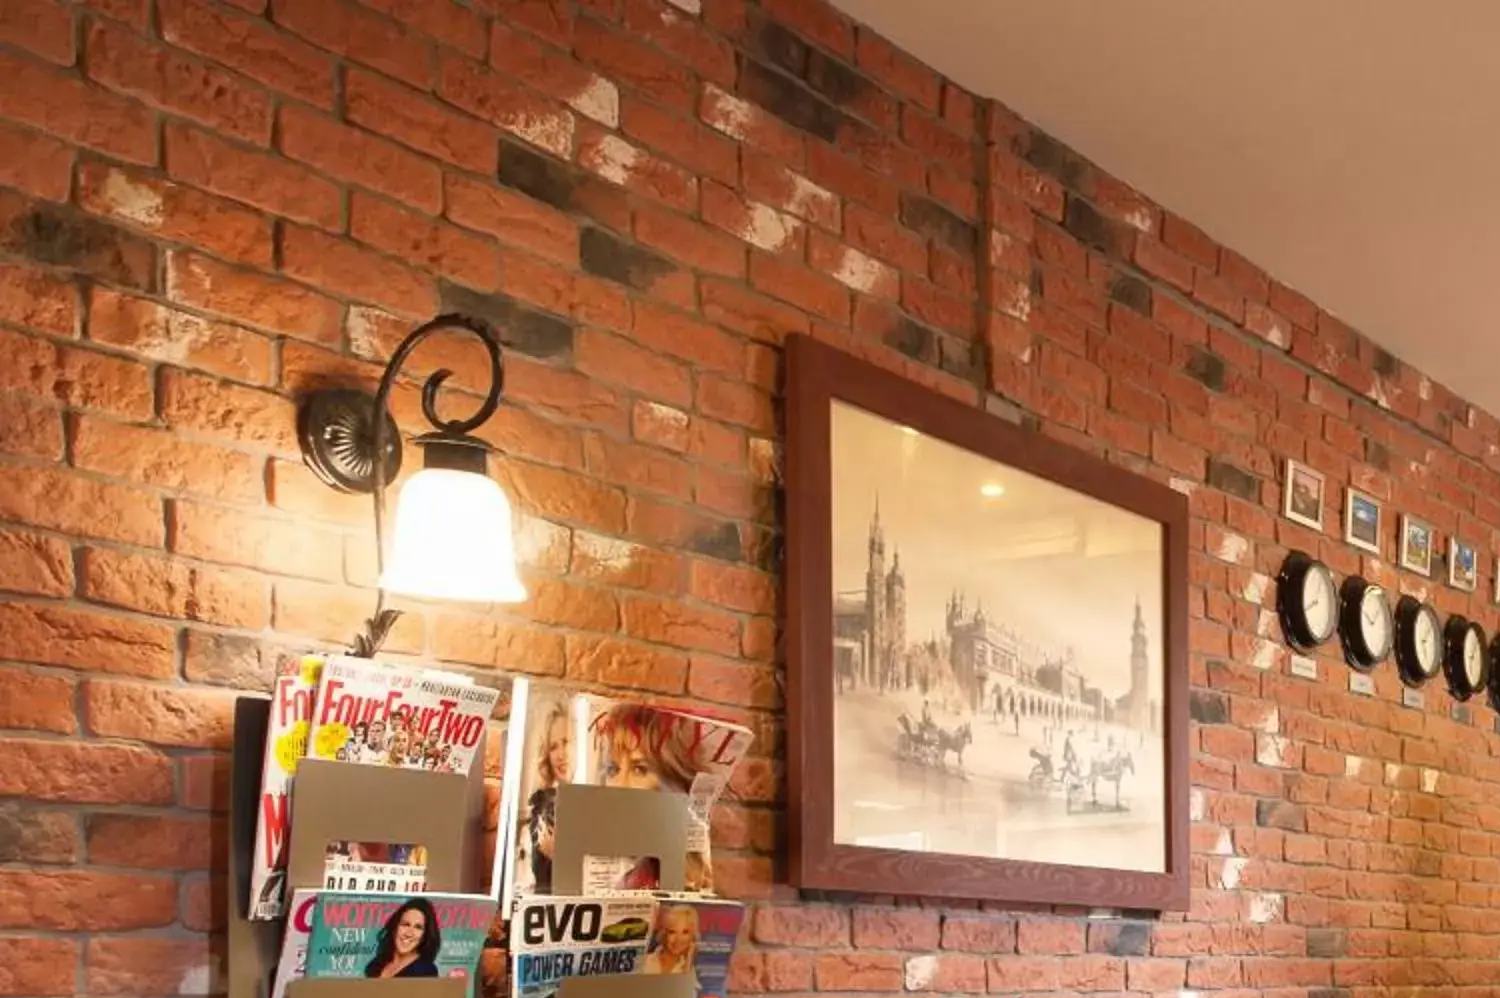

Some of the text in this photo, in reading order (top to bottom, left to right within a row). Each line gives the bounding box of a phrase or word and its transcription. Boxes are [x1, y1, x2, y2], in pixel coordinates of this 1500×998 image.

[523, 903, 602, 945] evo
[522, 949, 638, 984] POWER GAMES
